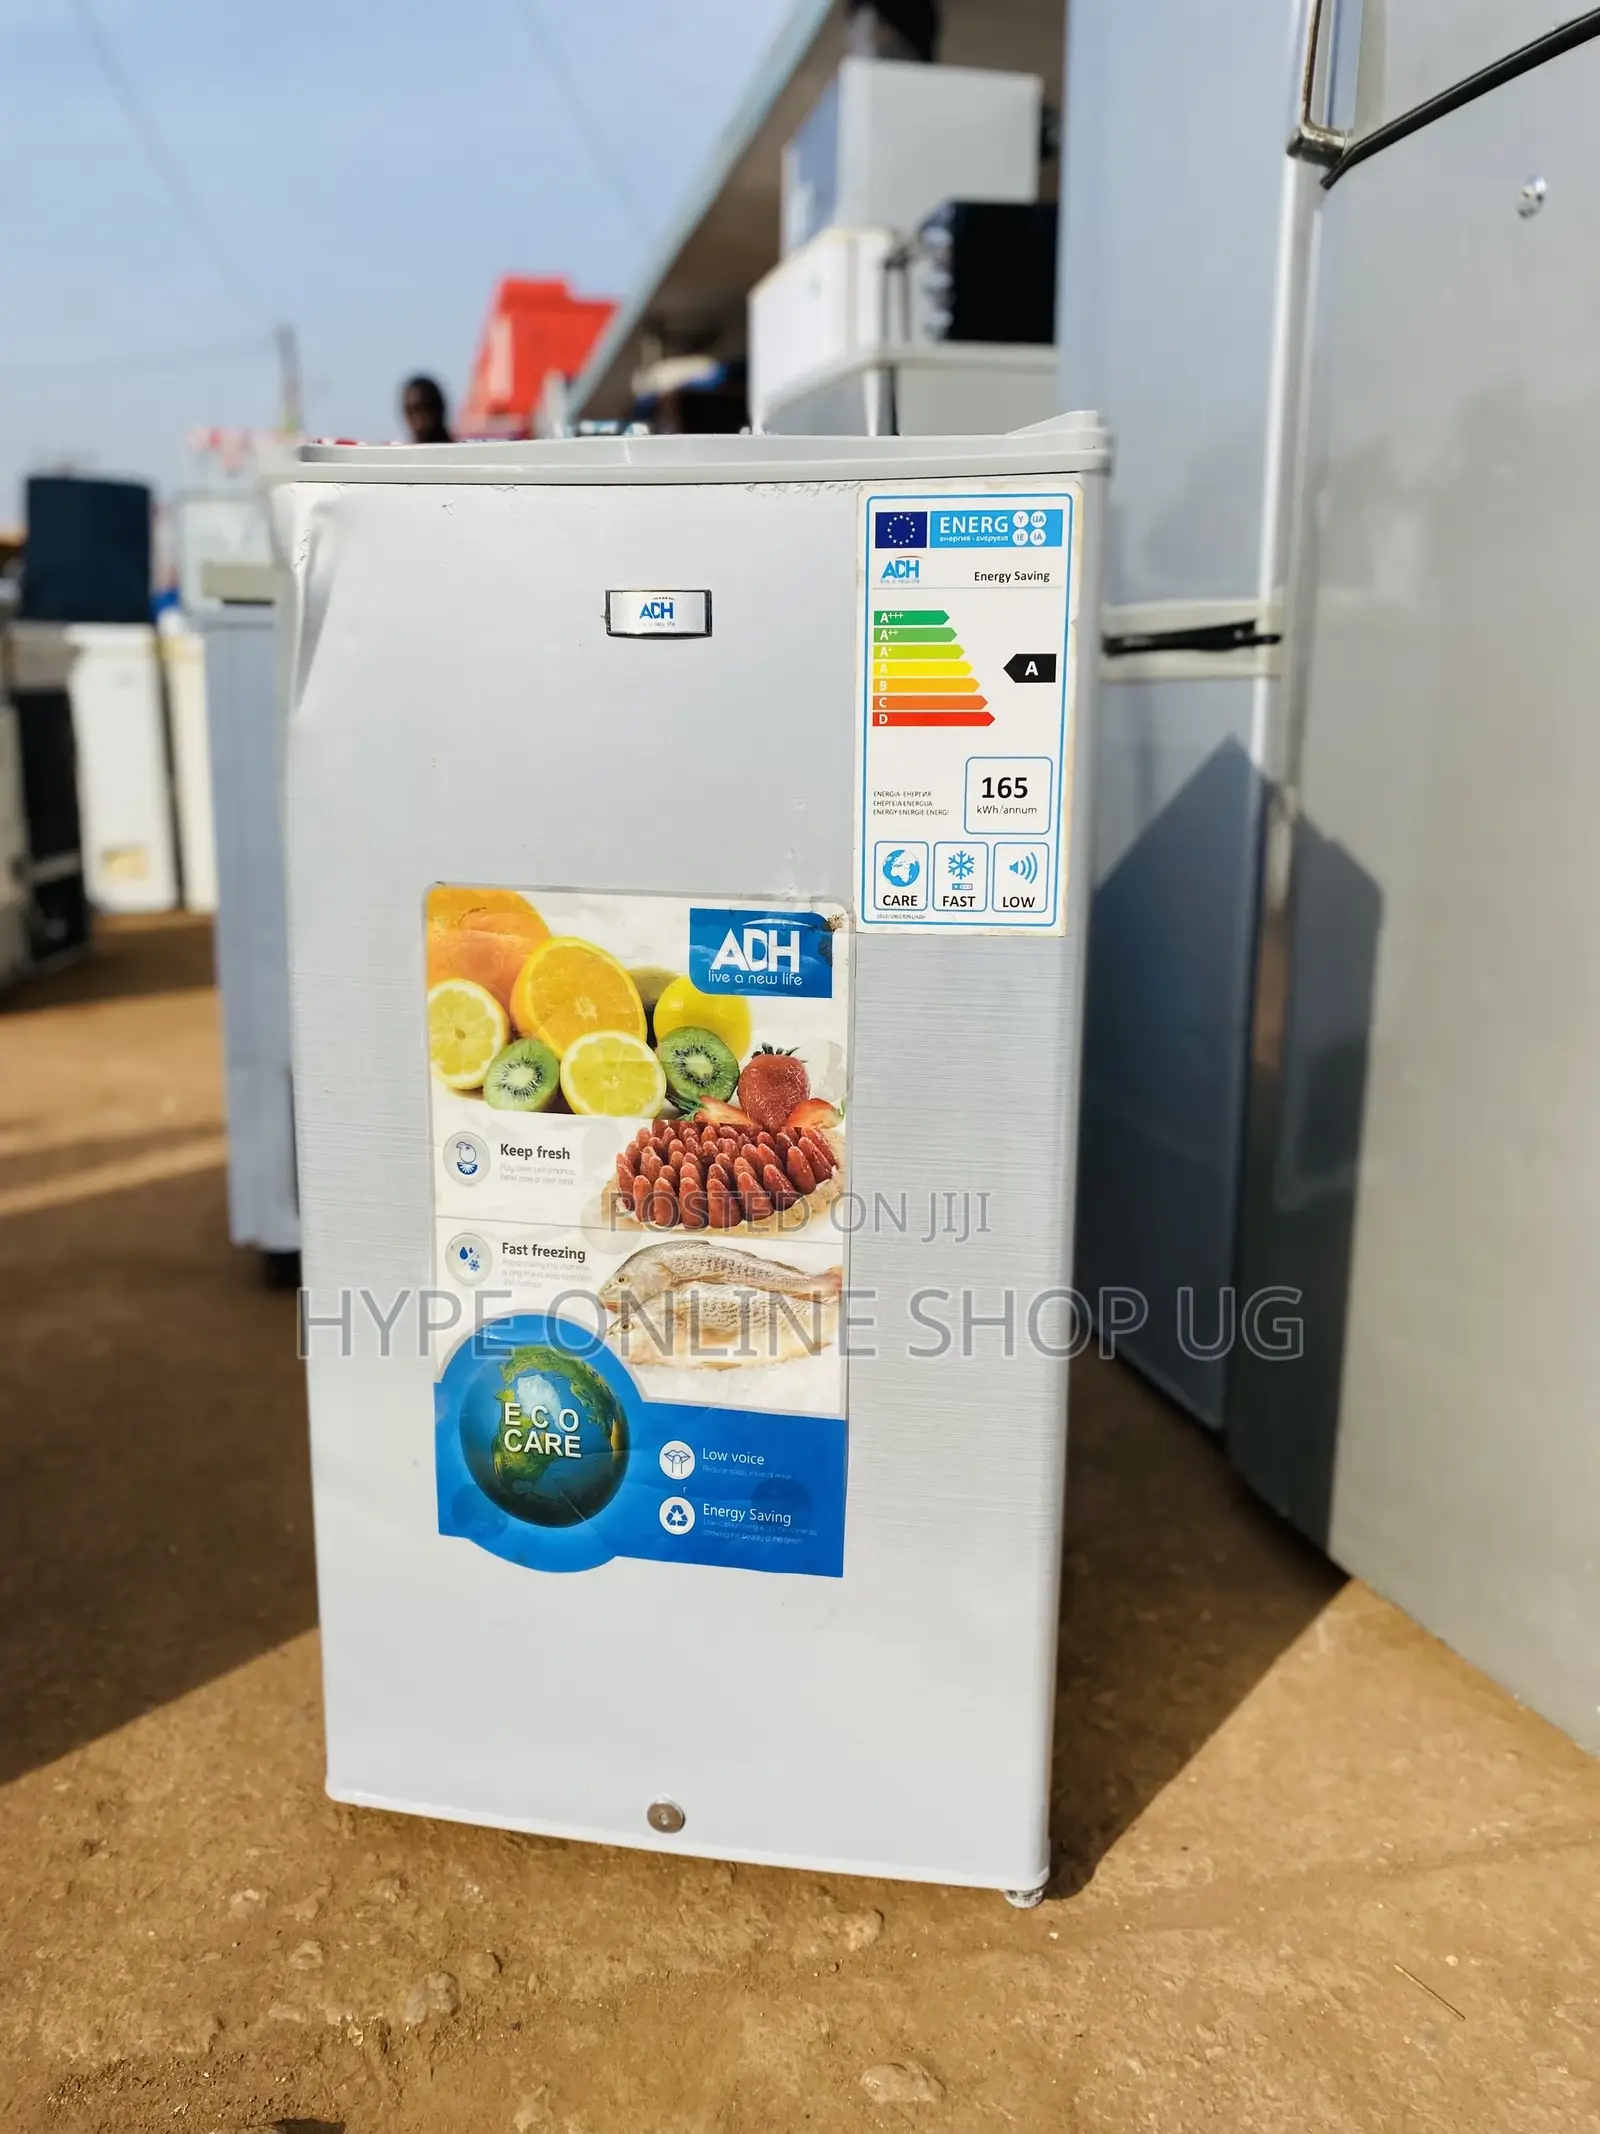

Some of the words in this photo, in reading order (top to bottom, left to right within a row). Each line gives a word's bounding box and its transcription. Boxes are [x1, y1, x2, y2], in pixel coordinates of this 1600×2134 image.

[939, 515, 1009, 534] ENERG
[1016, 533, 1024, 541] IE
[974, 571, 1012, 584] Energy
[1014, 570, 1050, 583] Saving
[1025, 661, 1039, 676] A
[880, 681, 887, 691] B
[879, 698, 887, 708] C
[879, 714, 888, 724] D
[981, 776, 1029, 799] 165
[882, 894, 918, 907] CARE
[942, 895, 976, 908] FAST
[1002, 896, 1036, 908] LOW
[710, 927, 800, 973] ADH
[708, 969, 731, 984] live
[734, 974, 744, 984] a
[748, 974, 778, 985] new
[782, 972, 803, 986] life
[500, 1143, 533, 1160] Keep
[537, 1145, 571, 1160] fresh
[502, 1242, 529, 1256] Fast
[532, 1244, 586, 1264] freezing
[504, 1402, 580, 1432] ECO
[504, 1428, 582, 1459] CARE
[702, 1448, 729, 1462] Low
[731, 1451, 765, 1465] voice
[703, 1503, 746, 1522] Energy
[749, 1508, 792, 1527] Saving
